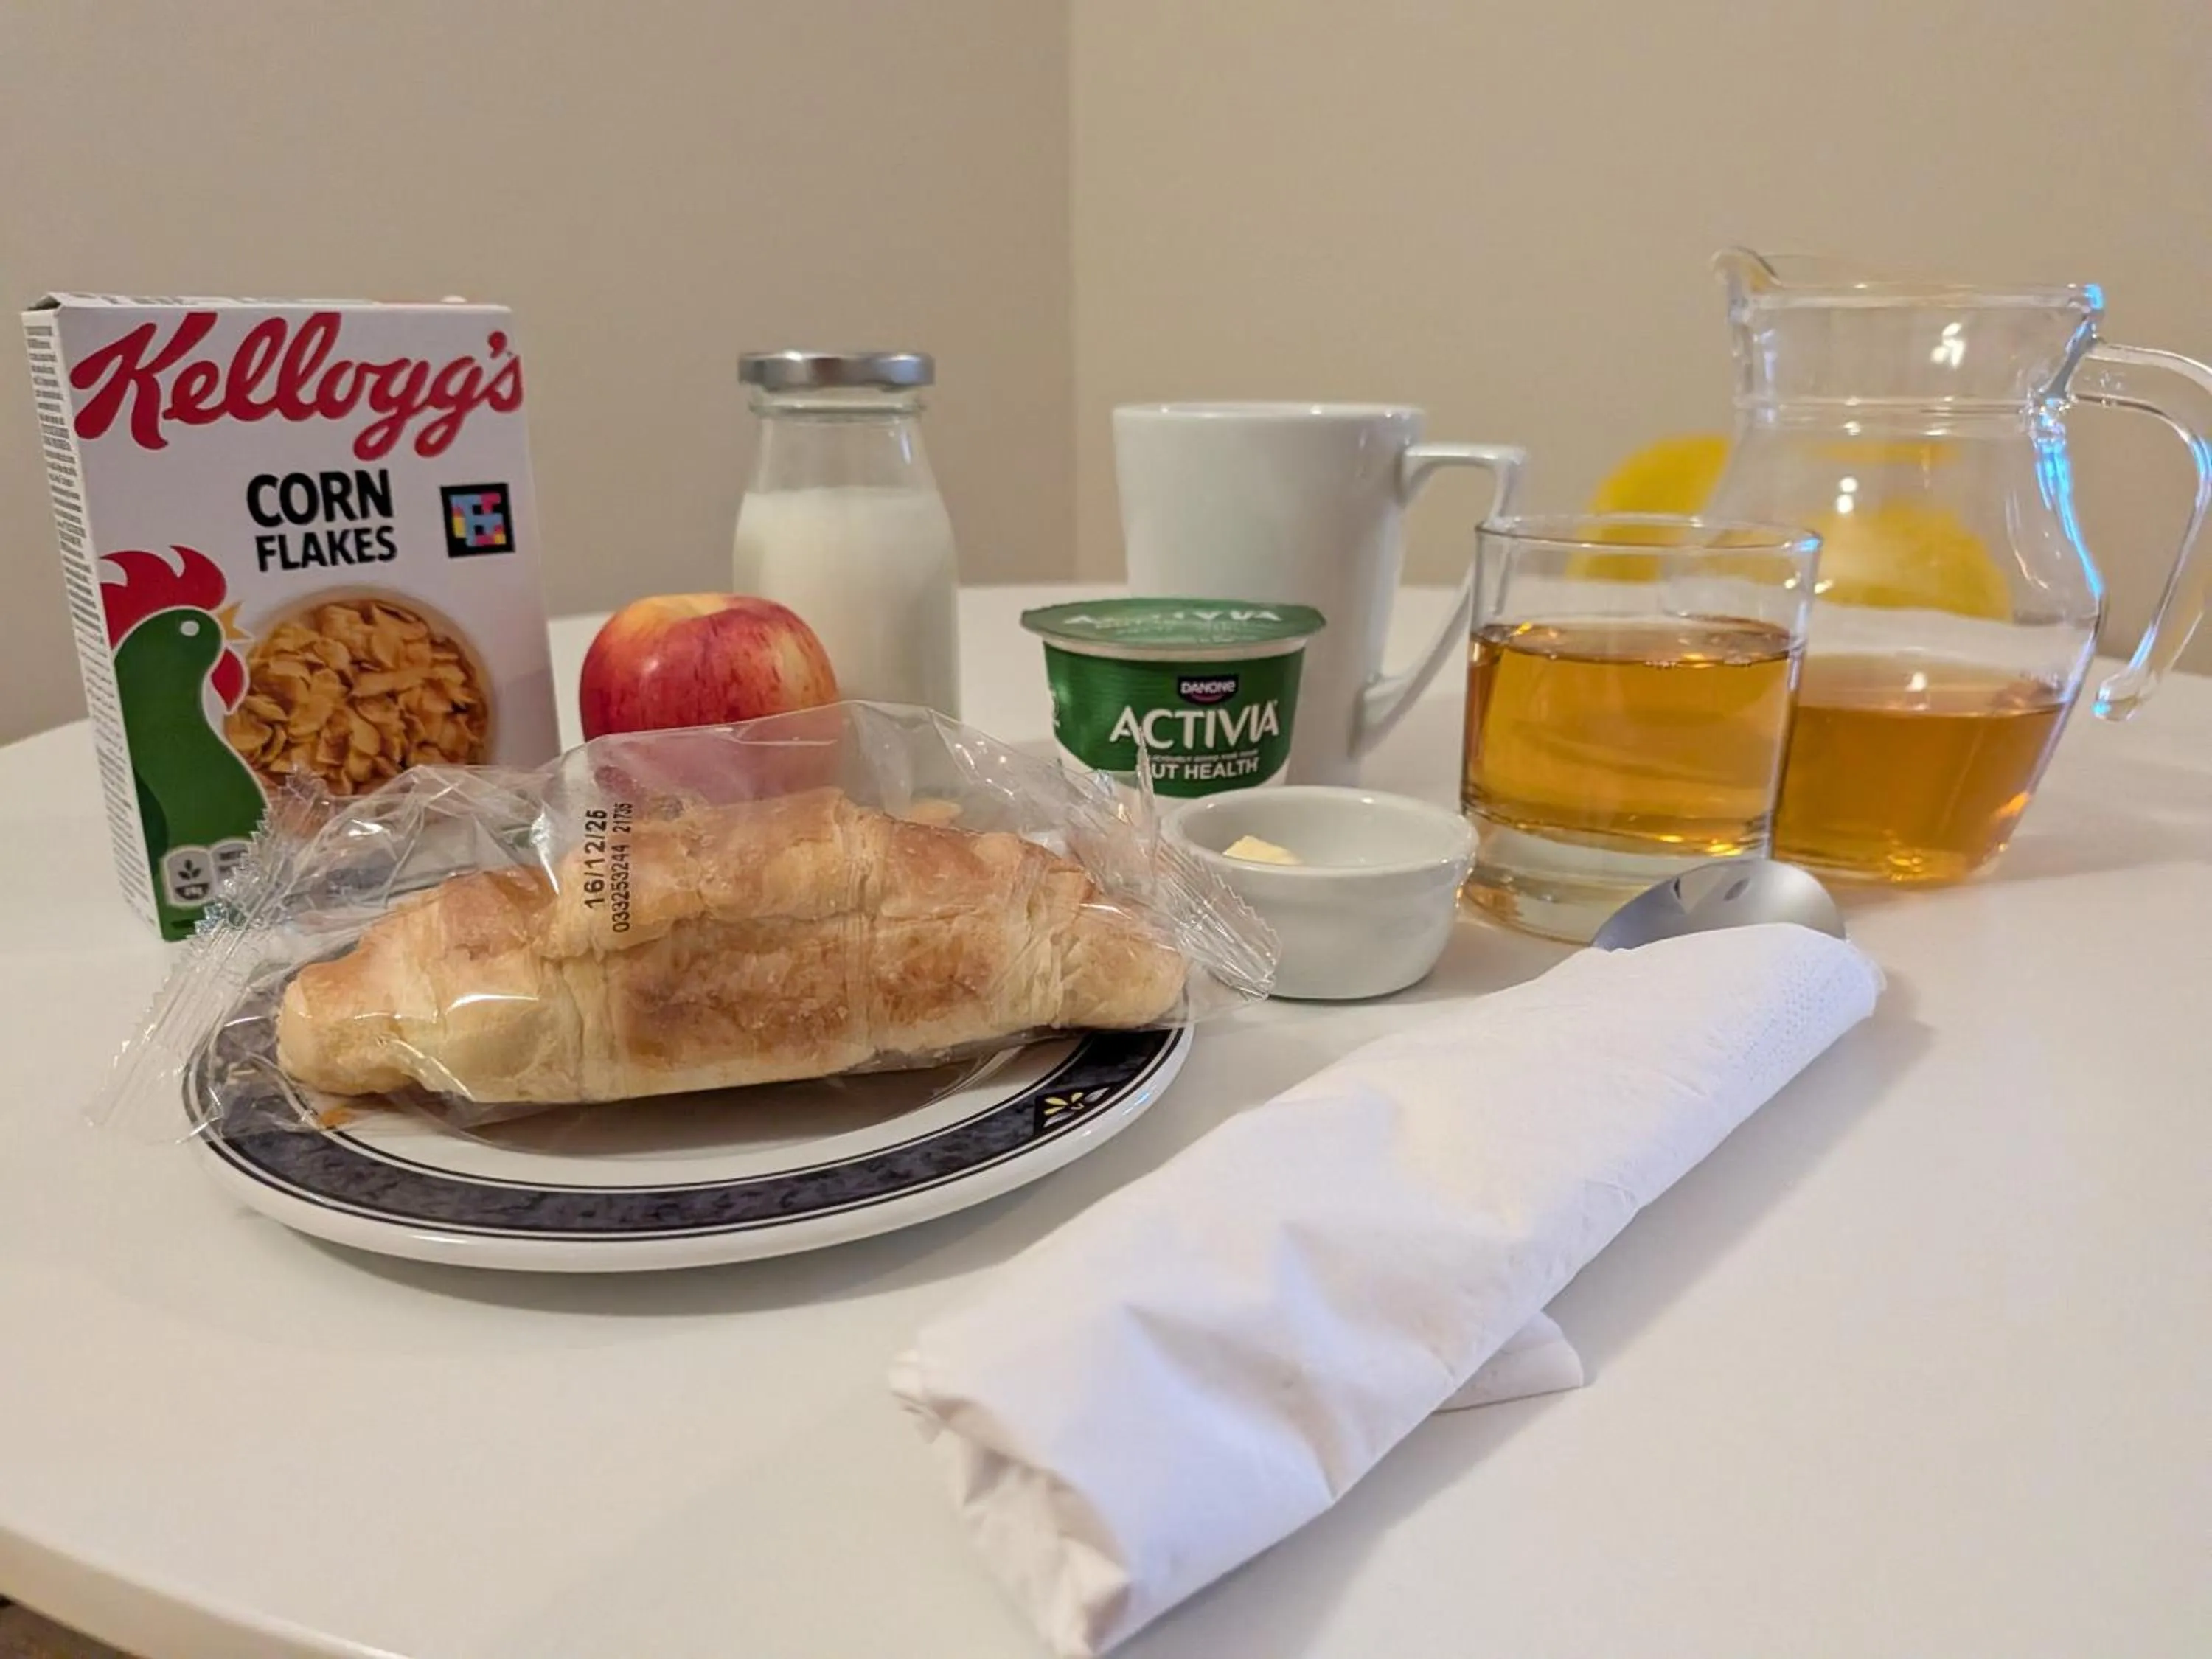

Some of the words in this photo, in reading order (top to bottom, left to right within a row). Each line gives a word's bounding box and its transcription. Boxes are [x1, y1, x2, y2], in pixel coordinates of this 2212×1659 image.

[70, 312, 523, 460] Kellogg's
[247, 469, 394, 527] CORN
[256, 526, 397, 571] FLAKES
[1109, 701, 1279, 749] ACTIVIA
[1150, 762, 1179, 779] UT
[1184, 757, 1259, 779] HEALTH
